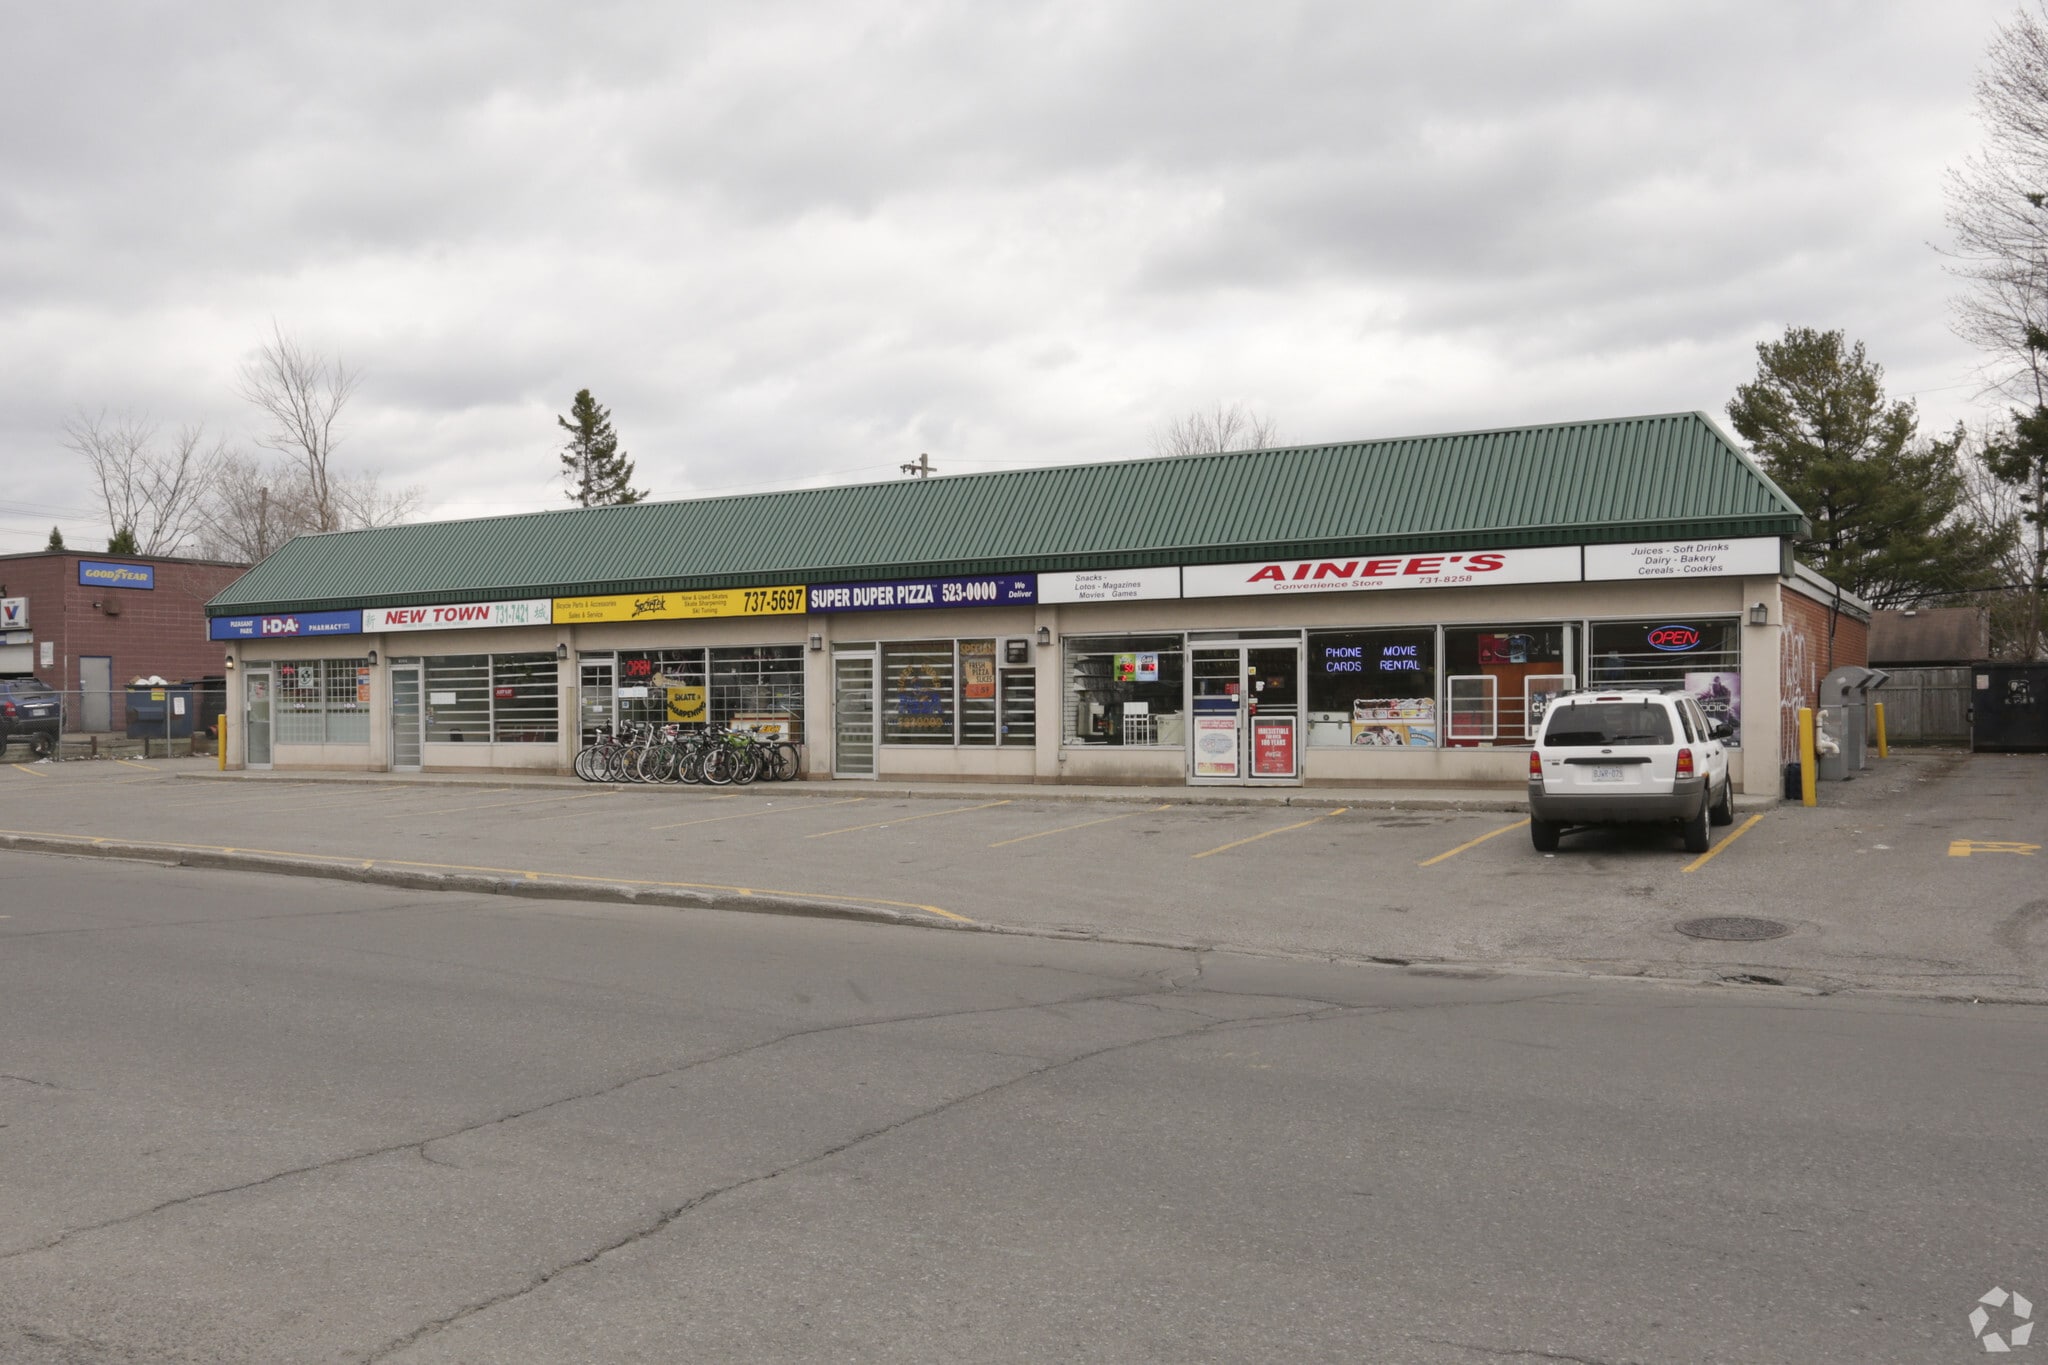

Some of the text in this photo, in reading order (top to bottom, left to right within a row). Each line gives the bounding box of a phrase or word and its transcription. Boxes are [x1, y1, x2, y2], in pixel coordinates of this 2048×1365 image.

[1631, 547, 1663, 556] Juices
[1673, 545, 1693, 553] Soft
[1696, 543, 1729, 552] Drinks
[1645, 556, 1671, 565] Dairy
[1680, 555, 1716, 564] Bakery
[1246, 554, 1505, 582] AINEE'S
[1638, 566, 1674, 575] Cereals
[1683, 564, 1723, 573] Cookies
[85, 568, 148, 582] GOODYEAR
[1075, 574, 1102, 582] Snacks
[1418, 575, 1473, 584] 731-8258
[1014, 581, 1026, 590] We
[1102, 581, 1141, 590] Magazines
[1273, 579, 1383, 590] Convenience Store
[811, 584, 934, 609] SUPER DUPER PIZZA
[942, 581, 997, 602] 523-0000
[1008, 590, 1033, 599] Deliver
[1079, 590, 1137, 599] Movies Games
[743, 588, 803, 613] 737-5697
[385, 609, 427, 625] NEW
[433, 606, 490, 622] TOWN
[495, 604, 529, 624] 731-7421
[309, 624, 341, 632] PHARMACY
[1650, 630, 1699, 645] OPEN
[1325, 647, 1362, 658] PHONE
[1383, 646, 1417, 656] MOVIE
[626, 660, 651, 677] OPEN
[1326, 661, 1362, 672] CARDS
[1379, 660, 1421, 671] RENTAL
[972, 668, 989, 676] PIZZA
[674, 693, 695, 701] SKATE
[667, 701, 706, 718] SHARPENING
